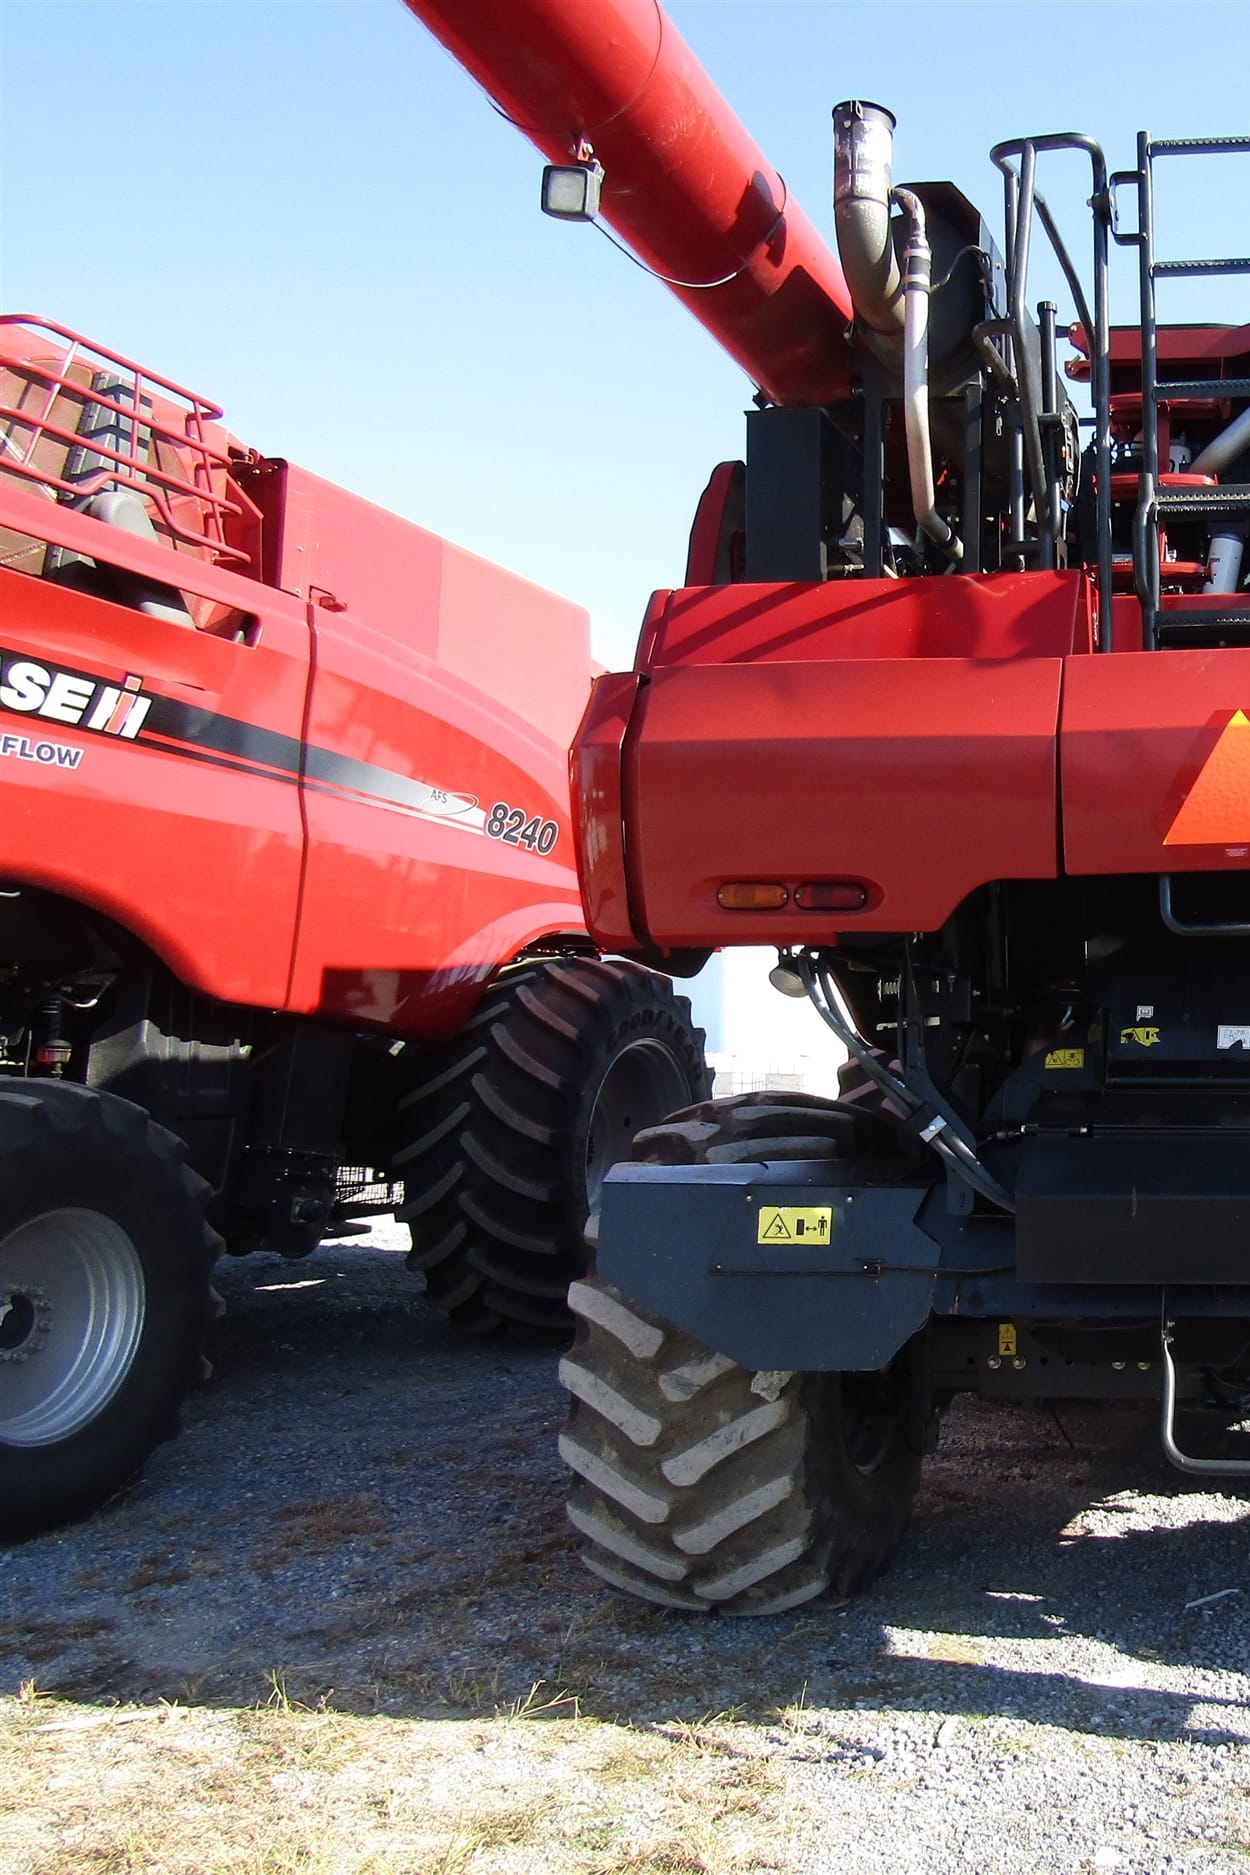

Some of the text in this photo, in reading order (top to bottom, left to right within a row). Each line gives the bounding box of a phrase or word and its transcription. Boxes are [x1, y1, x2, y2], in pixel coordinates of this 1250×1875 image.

[0, 661, 97, 725] SE
[430, 789, 448, 804] AFS
[487, 803, 558, 854] 8240
